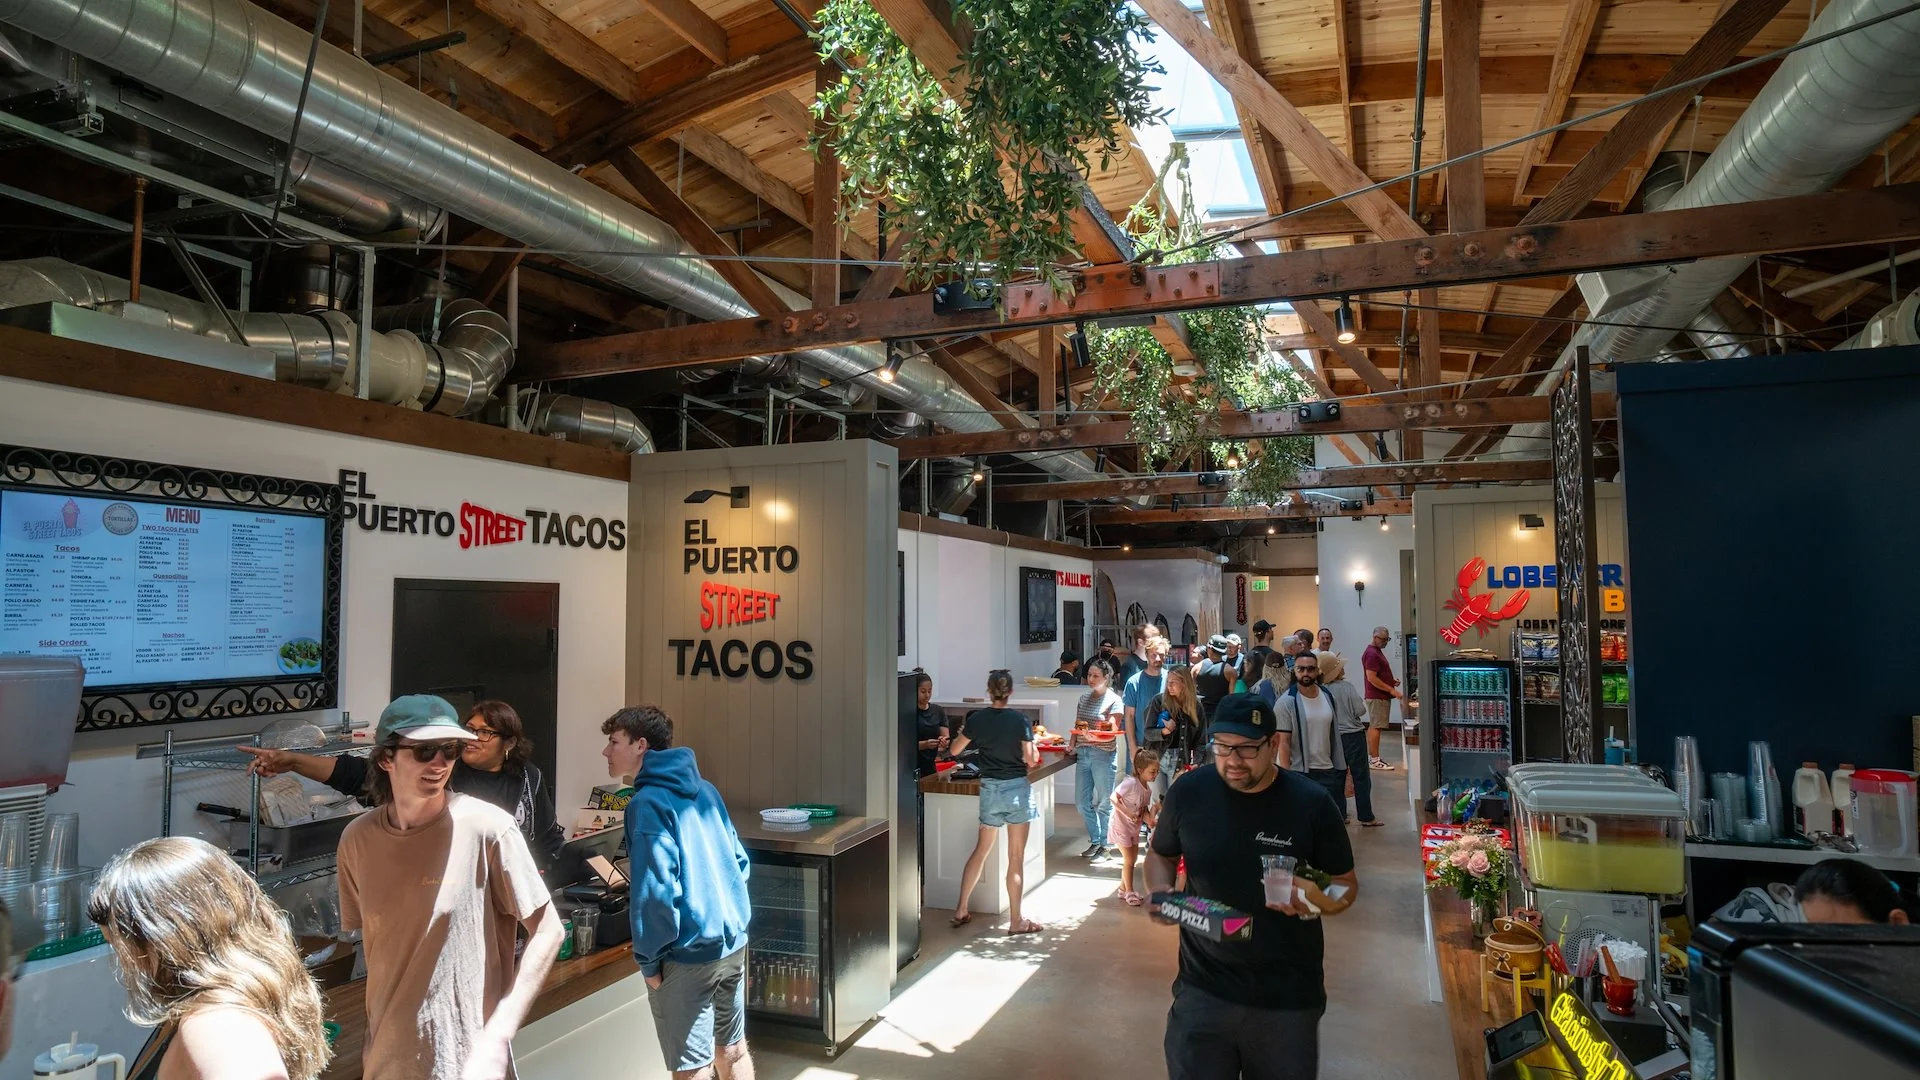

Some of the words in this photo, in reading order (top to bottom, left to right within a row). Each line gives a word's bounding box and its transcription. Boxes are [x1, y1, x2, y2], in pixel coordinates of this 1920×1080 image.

[339, 468, 376, 500] EL
[142, 524, 156, 532] TWO
[166, 507, 201, 524] MENU
[344, 501, 455, 537] PUERTO
[459, 501, 526, 549] STREET
[526, 509, 626, 551] TACOS
[684, 519, 717, 546] EL
[55, 544, 81, 552] Tacos
[684, 545, 799, 575] PUERTO
[1080, 573, 1092, 588] RICE
[1255, 581, 1266, 590] EXIT
[1487, 564, 1624, 589] LOBSR
[700, 581, 781, 632] STREET
[1600, 619, 1625, 629] ORE
[668, 639, 815, 681] TACOS
[1161, 901, 1180, 919] ODD
[1181, 909, 1210, 933] PIZZA
